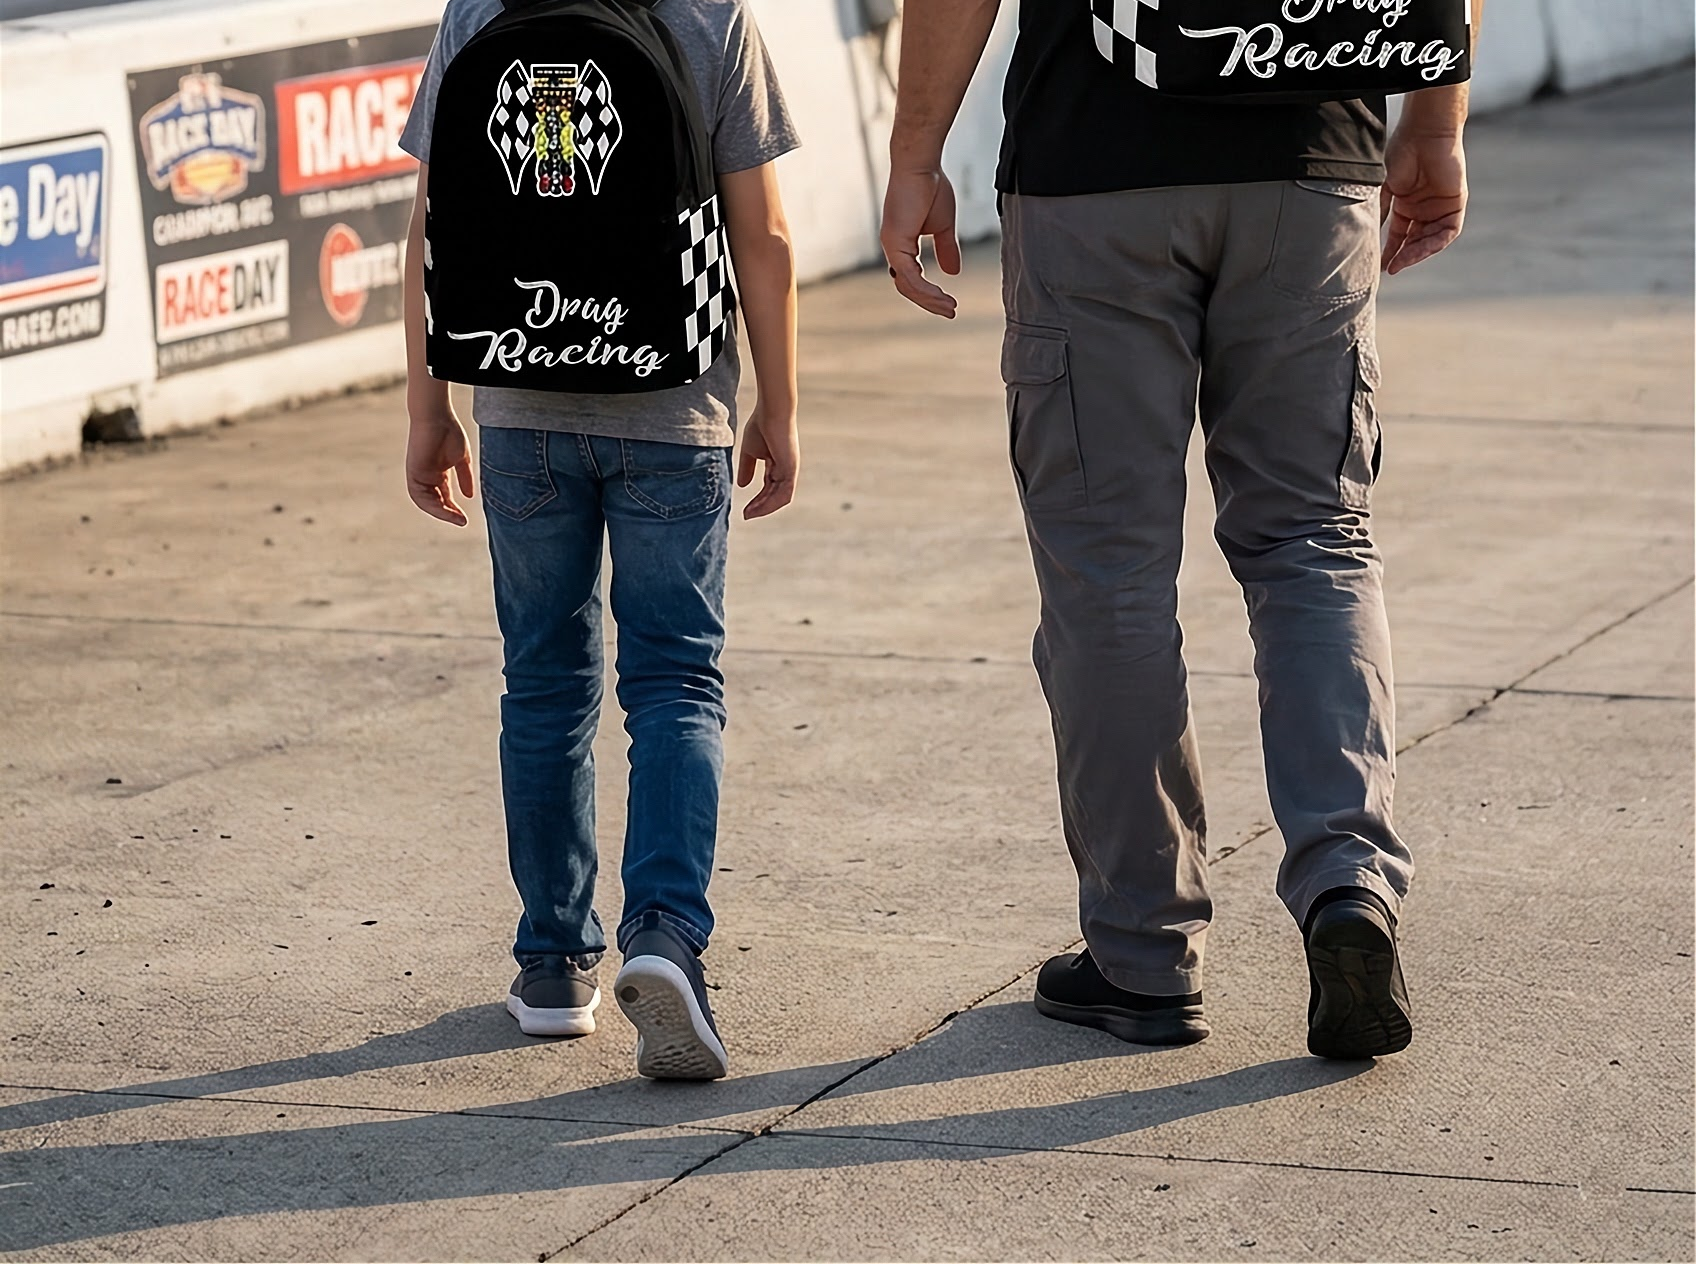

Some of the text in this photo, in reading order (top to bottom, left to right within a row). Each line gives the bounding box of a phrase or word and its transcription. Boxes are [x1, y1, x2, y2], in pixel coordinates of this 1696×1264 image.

[1178, 22, 1464, 81] Racing
[149, 114, 210, 173] RACE
[28, 163, 100, 248] Day
[164, 254, 280, 328] RACEDAY
[514, 277, 629, 335] Drag
[447, 328, 670, 377] Racing
